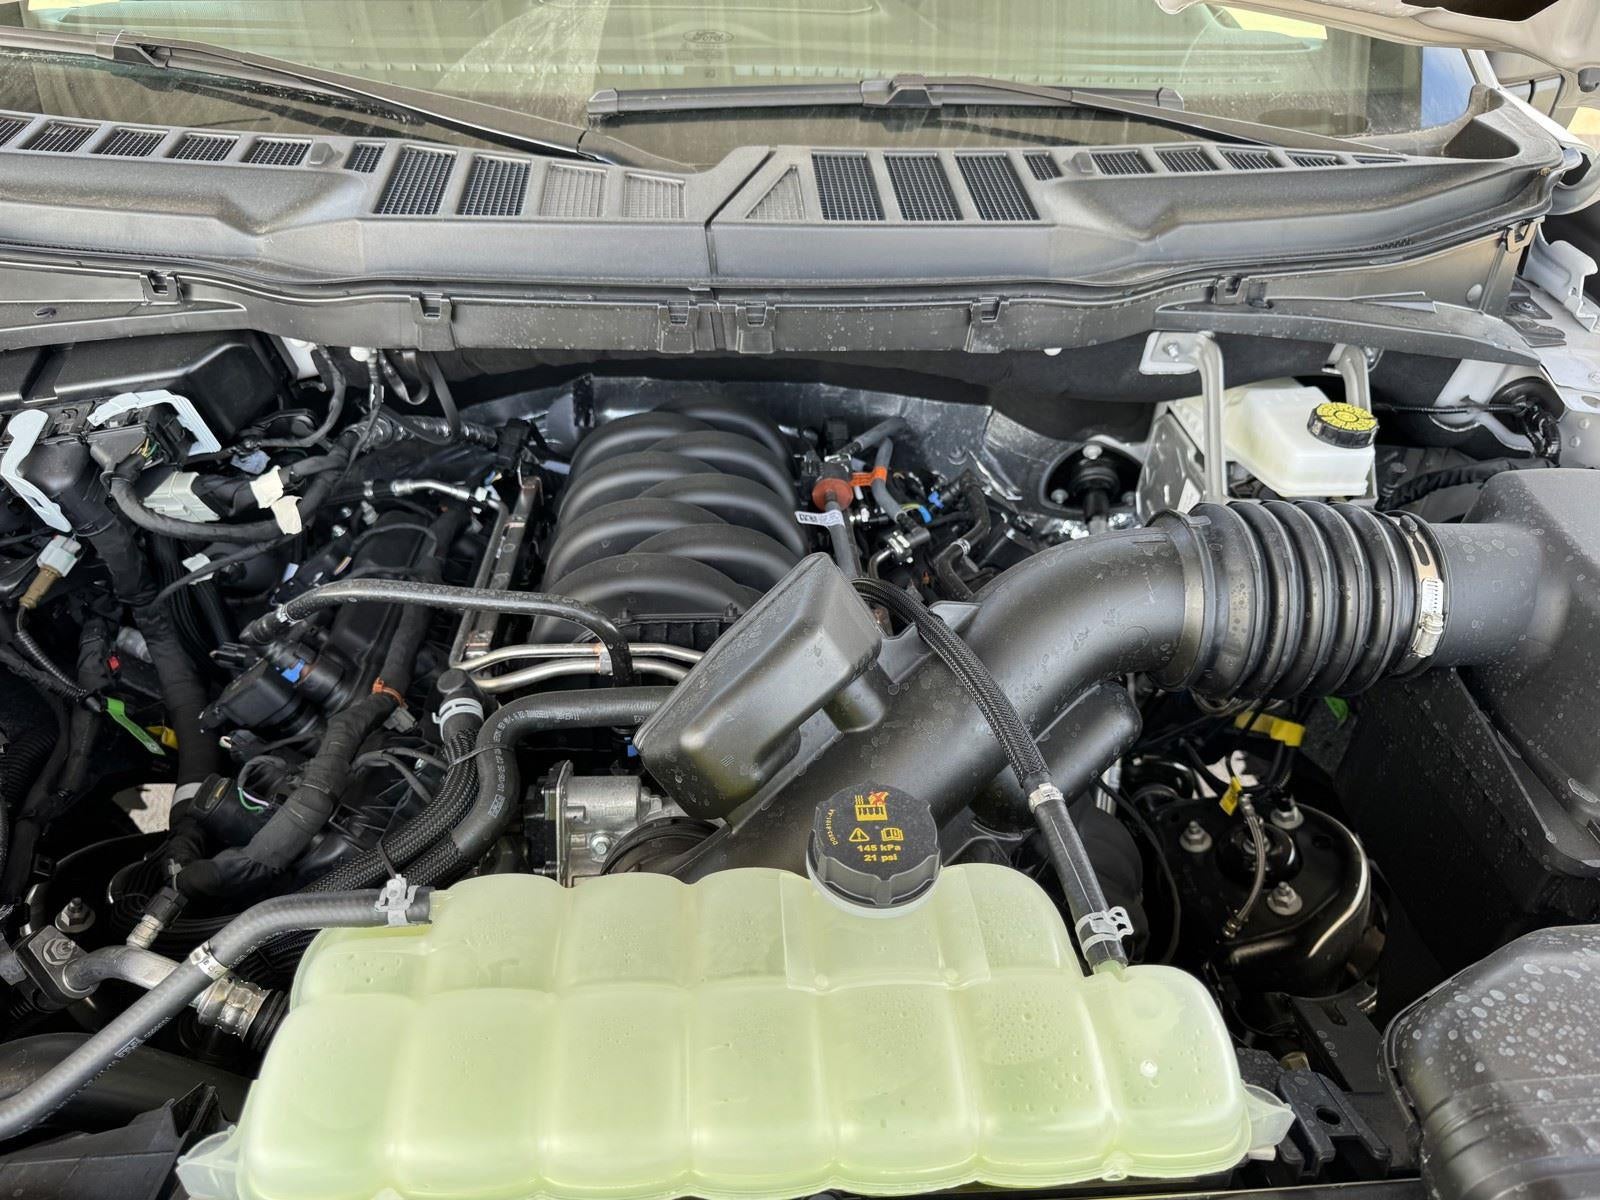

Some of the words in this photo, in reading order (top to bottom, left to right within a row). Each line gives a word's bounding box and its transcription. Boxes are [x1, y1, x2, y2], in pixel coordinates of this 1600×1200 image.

[857, 844, 878, 852] 145
[880, 844, 901, 852] kPa
[863, 854, 877, 862] 21
[881, 853, 897, 863] psi
